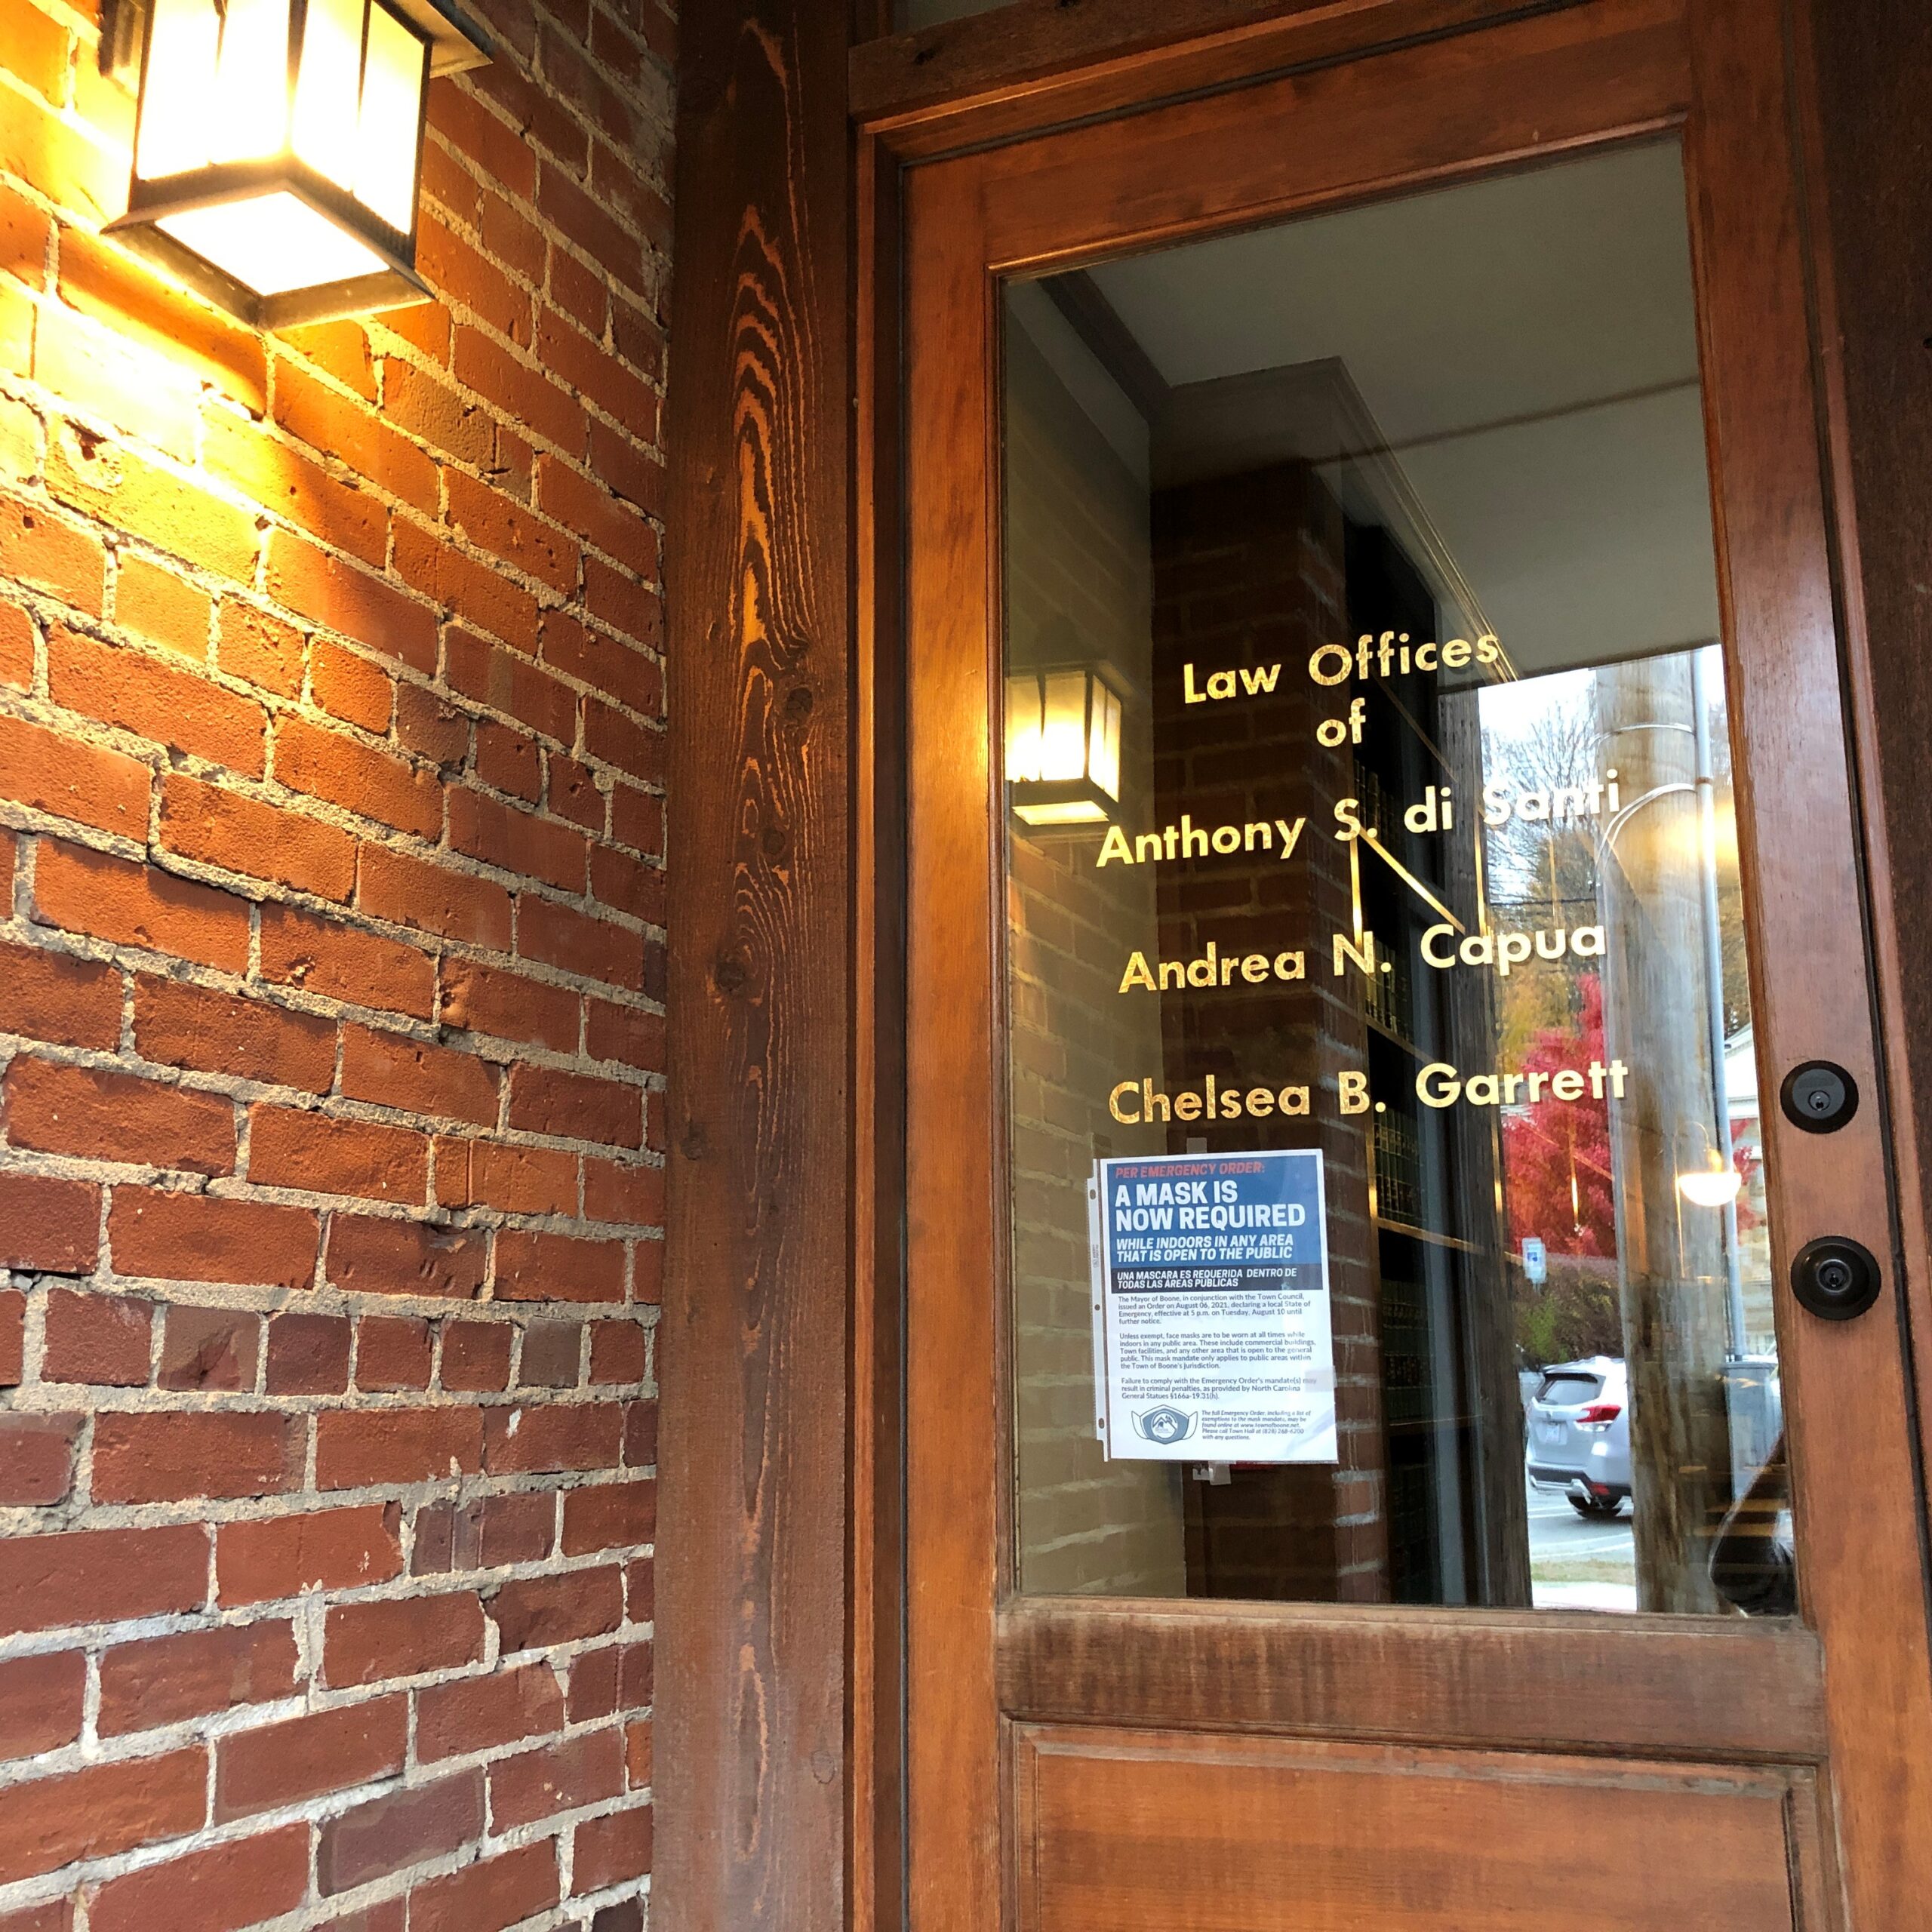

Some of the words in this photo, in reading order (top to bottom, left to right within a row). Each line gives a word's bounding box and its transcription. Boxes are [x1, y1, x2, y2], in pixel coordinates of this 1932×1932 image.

[1183, 663, 1281, 703] Law
[1309, 631, 1499, 686] Offices
[1316, 697, 1366, 748] of
[1096, 815, 1306, 867] Anthony
[1334, 798, 1378, 841] S.
[1404, 786, 1452, 833] di
[1483, 769, 1620, 826] Santi
[1118, 942, 1306, 993] Andrea
[1333, 931, 1392, 977] N.
[1420, 924, 1606, 977] Capua
[1109, 1074, 1310, 1124] Chelsea
[1338, 1071, 1386, 1115] B.
[1416, 1059, 1629, 1108] Garrett
[1115, 1167, 1137, 1179] PER
[1140, 1163, 1215, 1177] EMERGENCY
[1219, 1161, 1266, 1174] ORDER:
[1114, 1183, 1131, 1208] A
[1136, 1181, 1207, 1206] MASK
[1214, 1180, 1238, 1204] IS
[1115, 1208, 1173, 1232] NOW
[1179, 1204, 1306, 1232] REQUIRED
[1115, 1238, 1153, 1250] WHILE
[1155, 1236, 1211, 1249] INDOORS
[1214, 1235, 1227, 1247] IN
[1229, 1235, 1257, 1247] ANY
[1259, 1234, 1294, 1246] AREA
[1116, 1251, 1147, 1262] THAT
[1149, 1250, 1161, 1262] IS
[1164, 1249, 1197, 1261] OPEN
[1199, 1249, 1216, 1260] TO
[1219, 1248, 1242, 1260] THE
[1245, 1247, 1294, 1260] PUBLIC
[1116, 1271, 1134, 1280] UNA
[1180, 1270, 1191, 1279] ES
[1192, 1269, 1242, 1279] REQUERIDA
[1246, 1268, 1283, 1278] DENTRO
[1284, 1268, 1298, 1277] DE
[1117, 1280, 1145, 1289] TODAS
[1146, 1280, 1162, 1289] LAS
[1189, 1294, 1227, 1303] conjunction
